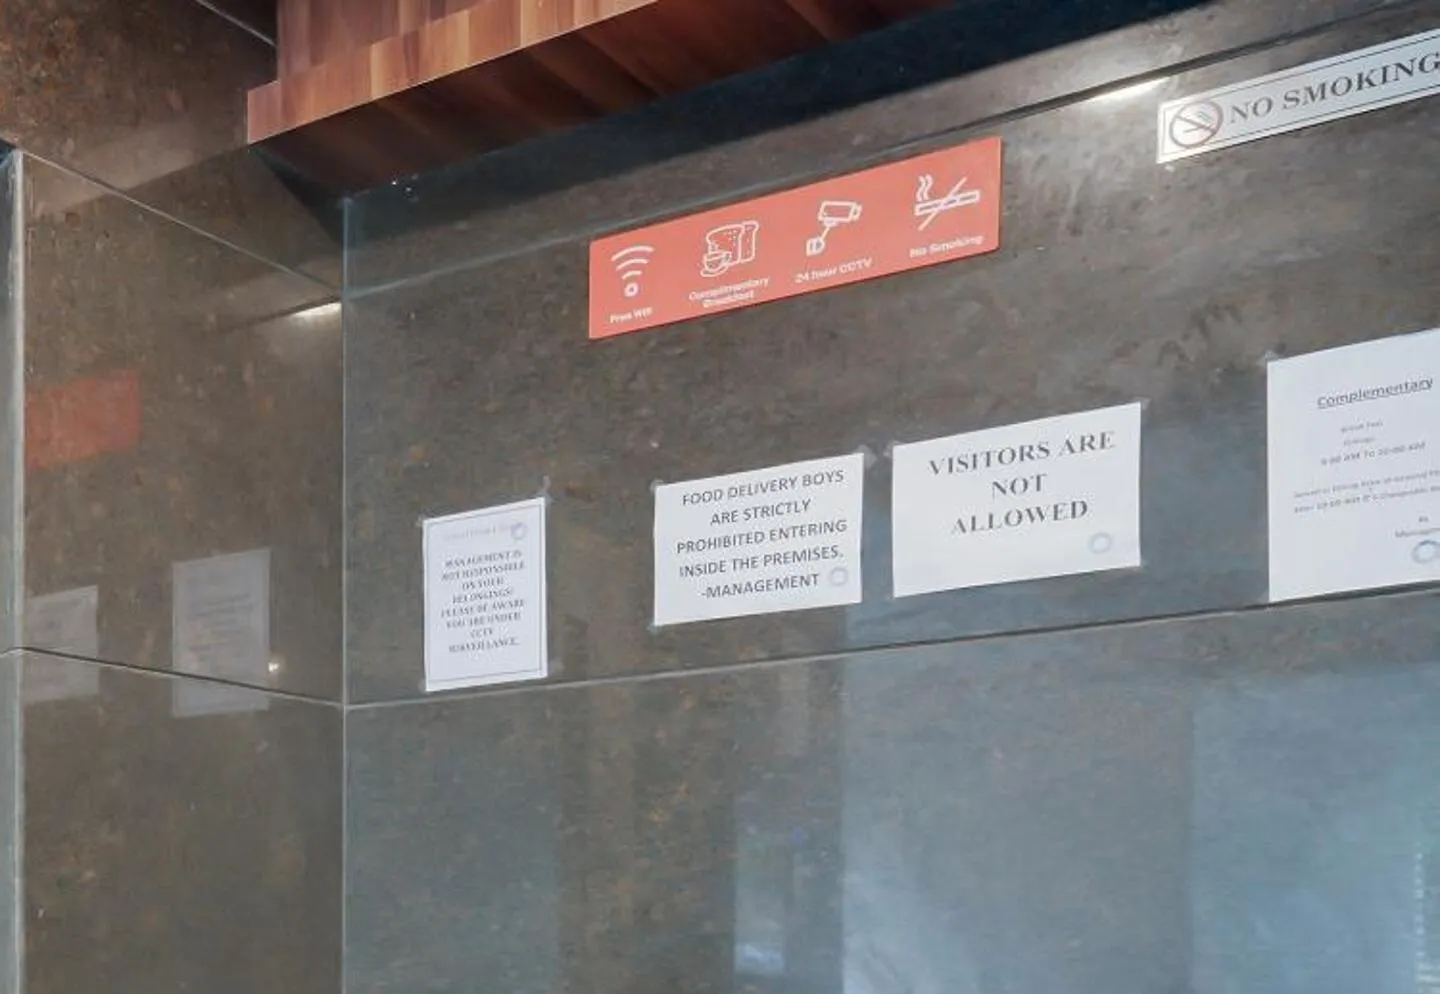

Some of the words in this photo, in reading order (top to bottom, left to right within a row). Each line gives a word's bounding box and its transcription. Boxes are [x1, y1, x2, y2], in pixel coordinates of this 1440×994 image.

[1230, 98, 1273, 123] NO
[1281, 52, 1440, 111] SMOKING
[928, 235, 984, 258] Smoking
[839, 257, 873, 276] CCTV
[1316, 376, 1434, 410] Complementary
[927, 440, 1051, 476] VISITORS
[1057, 430, 1117, 457] ARE
[682, 488, 723, 507] FOOD
[727, 475, 798, 499] DELIVERY
[802, 469, 845, 488] BOYS
[991, 472, 1048, 499] NOT
[710, 509, 738, 526] ARE
[743, 498, 812, 522] STRICTLY
[950, 499, 1089, 535] ALLOWED
[676, 530, 765, 555] PROHIBITED
[769, 518, 848, 542] ENTERING
[679, 559, 727, 578] INSIDE
[732, 554, 759, 572] THE
[763, 544, 844, 568] PREMISES.
[701, 573, 821, 600] -MANAGEMENT
